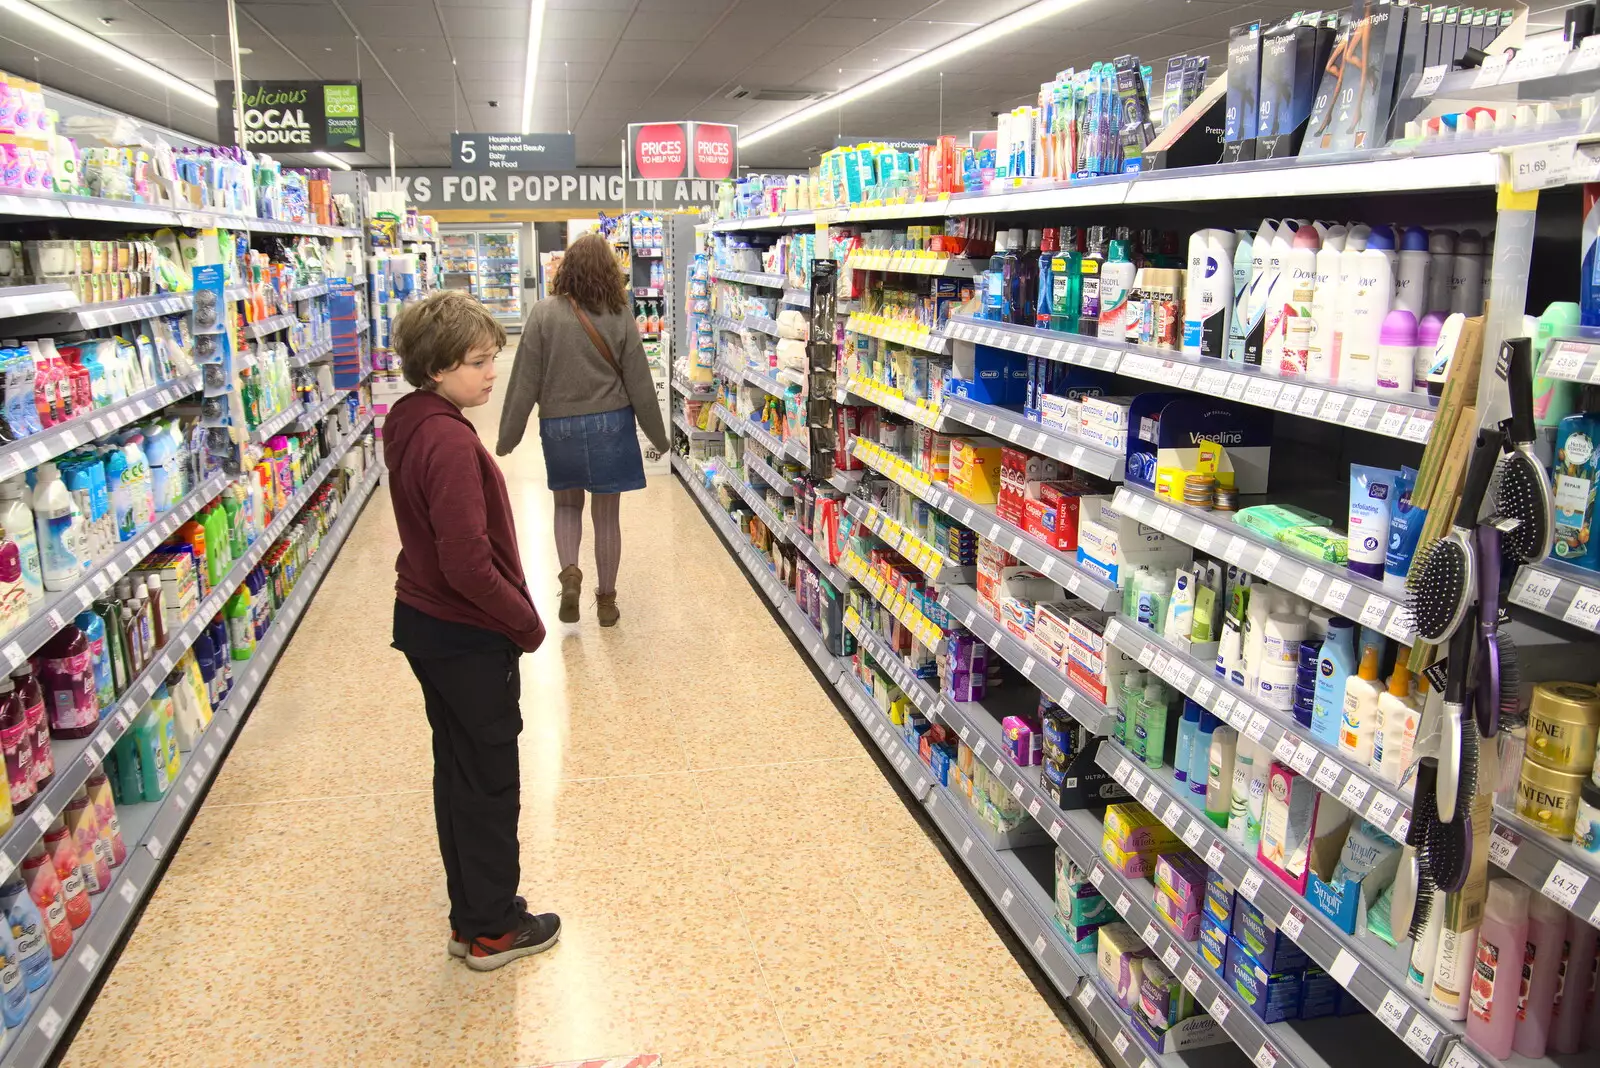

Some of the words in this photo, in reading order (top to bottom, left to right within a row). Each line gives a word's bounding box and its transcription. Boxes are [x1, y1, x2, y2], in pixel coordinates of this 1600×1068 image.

[1370, 12, 1389, 25] Tights
[1263, 38, 1275, 48] Semi
[1275, 33, 1296, 46] Opaque
[1271, 45, 1286, 56] Tights
[1315, 94, 1328, 109] 10
[1341, 88, 1354, 103] 10
[1226, 106, 1237, 120] 40
[1260, 101, 1271, 114] 40
[234, 109, 310, 129] OCAL
[328, 118, 357, 126] Sourced
[329, 126, 356, 136] Locally
[1205, 126, 1226, 136] Pretty
[488, 135, 522, 143] Household
[460, 141, 477, 163] 5
[523, 144, 545, 152] Beauty
[641, 141, 682, 156] PRICES
[698, 141, 729, 156] PRICES
[489, 152, 506, 160] Baby
[642, 156, 651, 164] TO
[651, 156, 667, 164] HELP
[667, 155, 681, 163] YOU
[698, 155, 706, 163] TO
[706, 156, 718, 164] HELP
[1519, 160, 1547, 175] £1.69
[443, 176, 498, 202] FOR
[507, 175, 624, 202] POPPING
[637, 181, 662, 200] IN
[1292, 267, 1317, 280] Dove
[1042, 400, 1064, 412] SENSODYNE
[1189, 431, 1242, 445] Vaseline
[1571, 441, 1587, 449] Herbal
[645, 450, 661, 462] 10p
[1564, 482, 1581, 490] REPAIR
[1025, 500, 1043, 518] Colgate
[1101, 506, 1121, 519] SENSODY
[1352, 502, 1379, 515] exfoliating
[1028, 525, 1049, 543] Colgate
[1525, 583, 1550, 598] £4.69
[1367, 605, 1385, 617] £2.99
[1573, 600, 1600, 616] £4.69
[1296, 752, 1312, 766] £4.19
[1320, 766, 1337, 780] £6.99
[1107, 784, 1114, 796] 4
[1272, 778, 1286, 796] Veet
[1347, 785, 1365, 799] £7.29
[1373, 801, 1392, 817] £8.49
[1490, 840, 1510, 857] £1.99
[1244, 878, 1258, 890] £4.99
[1551, 873, 1579, 896] £4.75
[1207, 881, 1230, 903] TAMPAX
[1313, 879, 1343, 914] Simply
[1318, 897, 1337, 917] Venus
[1242, 912, 1266, 938] TAMPAX
[1200, 929, 1222, 954] TAMPAX
[1233, 963, 1258, 990] TAMPAX
[1383, 1001, 1402, 1021] £5.99
[1182, 1019, 1219, 1033] always
[1411, 1025, 1432, 1047] £5.25
